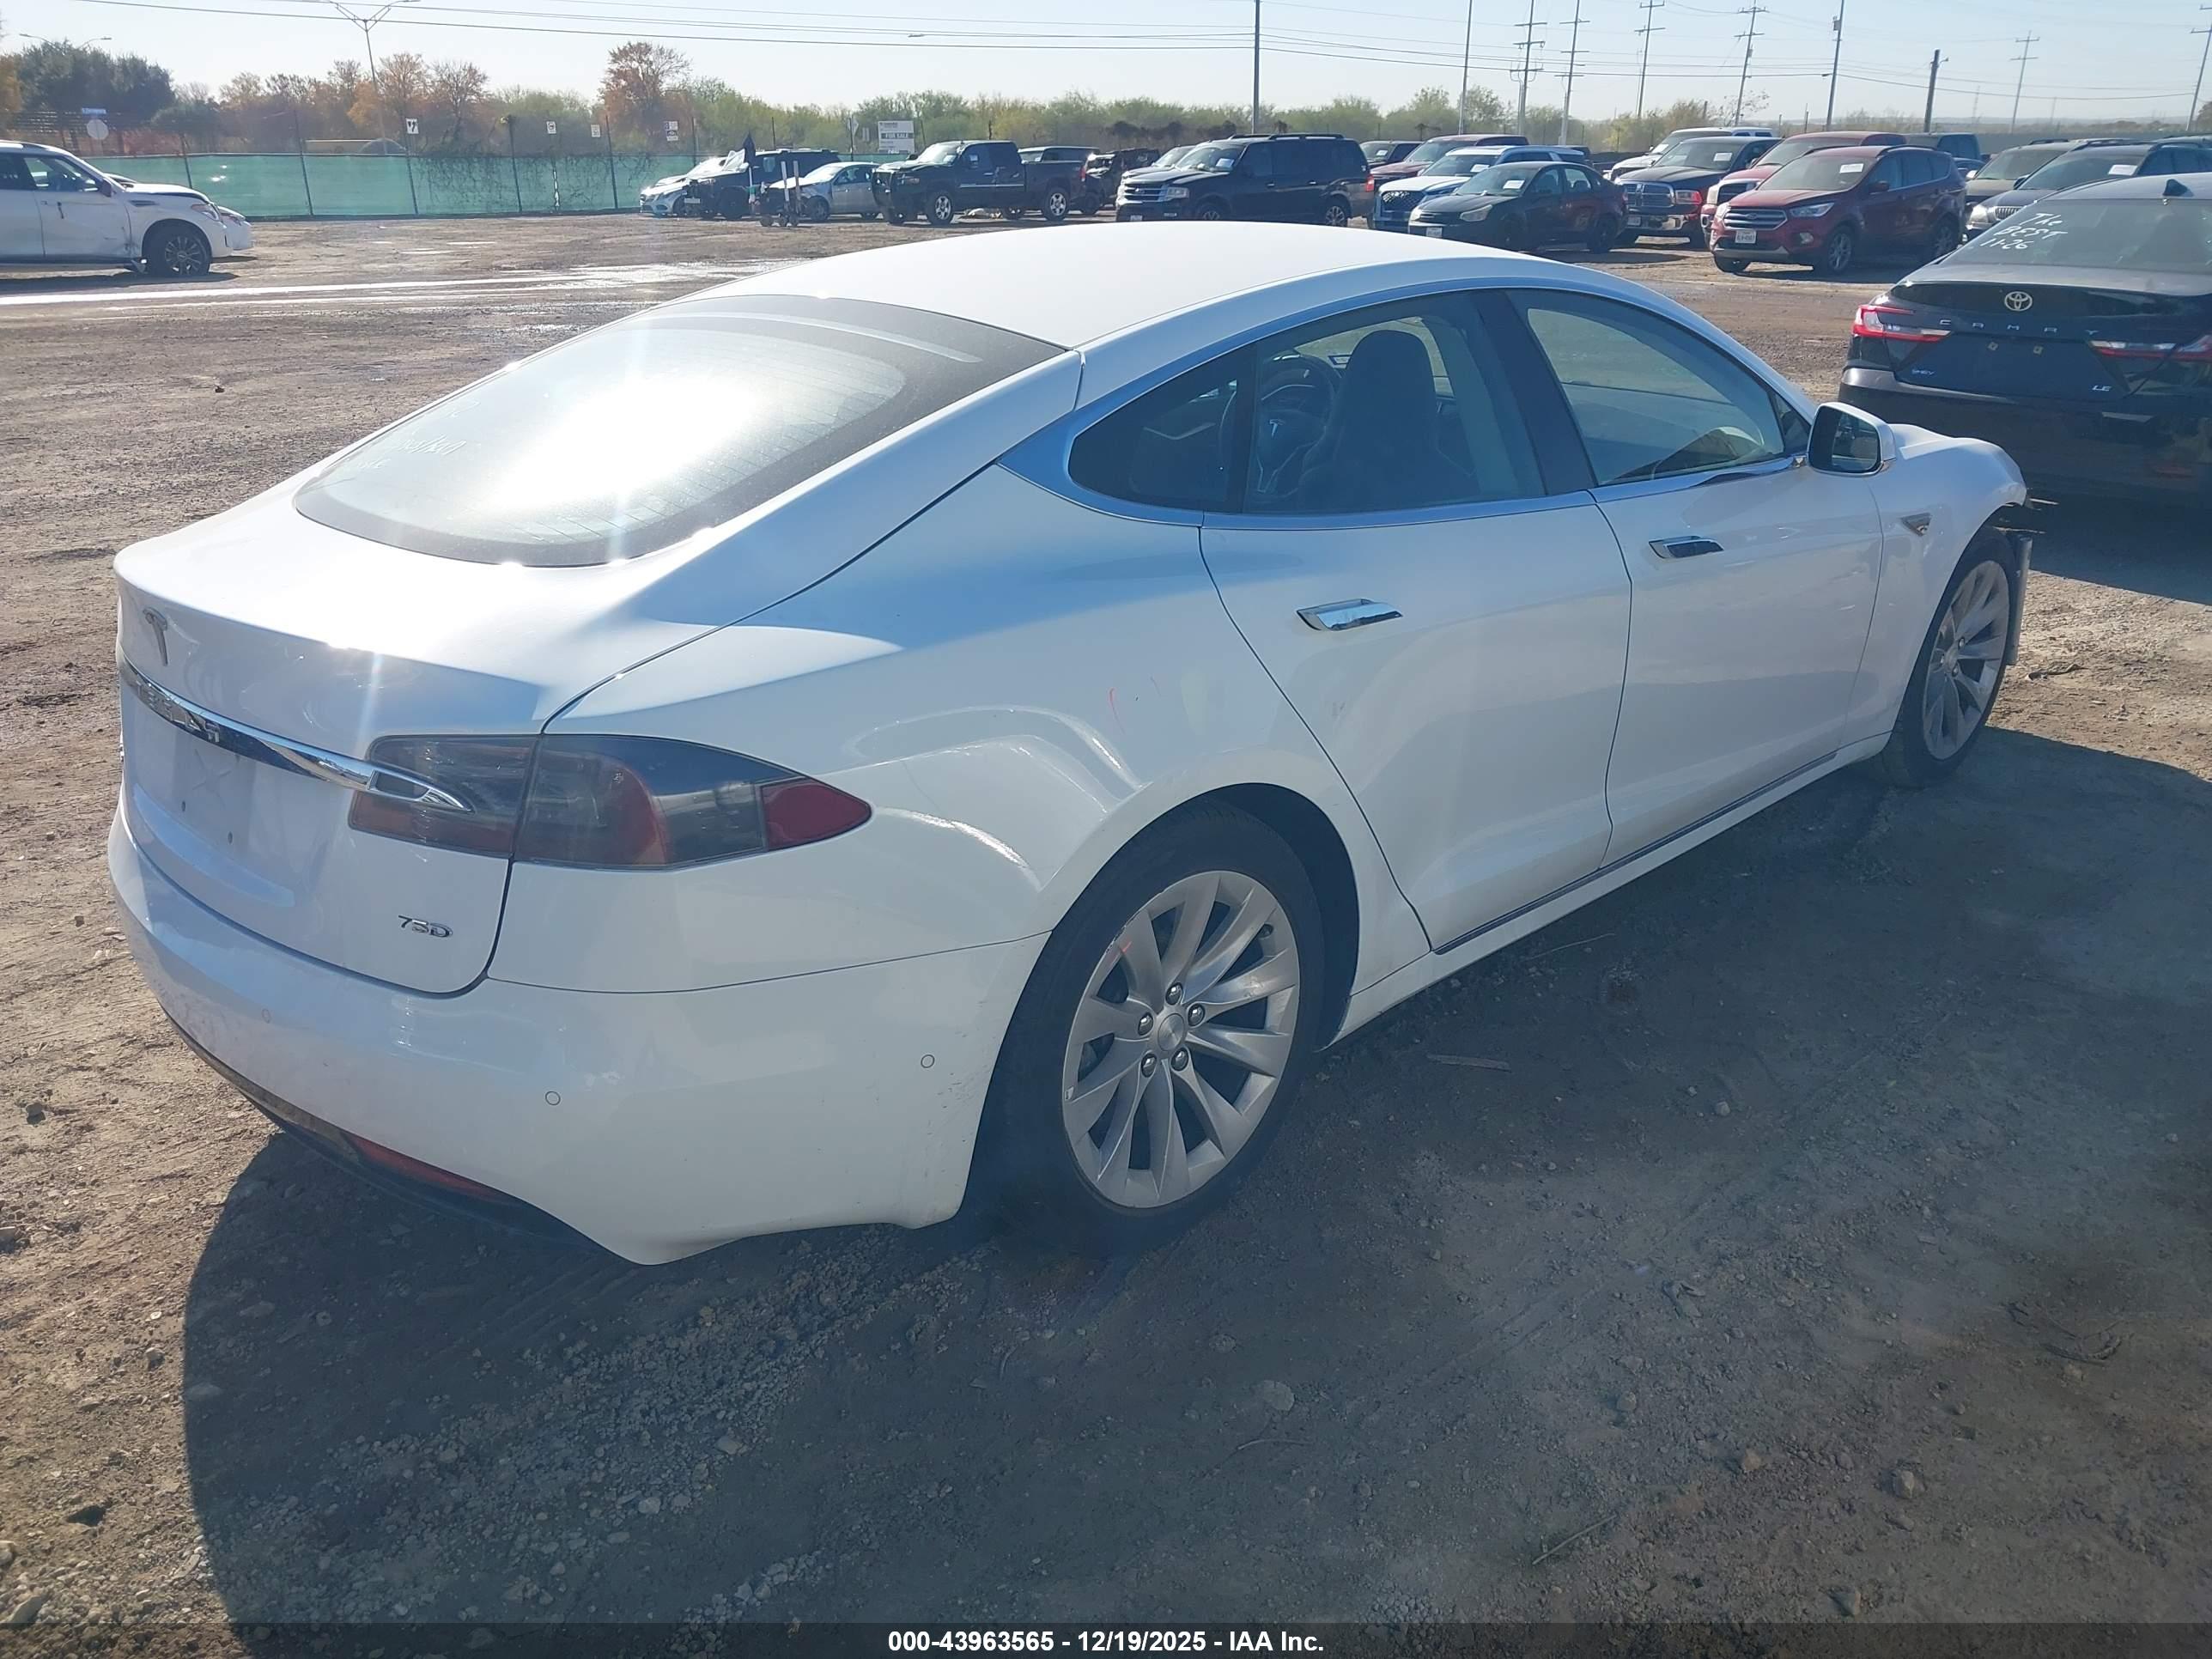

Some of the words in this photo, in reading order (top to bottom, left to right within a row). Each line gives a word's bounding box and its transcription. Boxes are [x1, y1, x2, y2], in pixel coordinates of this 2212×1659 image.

[2019, 213, 2063, 226] The
[1939, 319, 2099, 336] CAMRY
[2092, 384, 2112, 392] LE
[398, 915, 453, 938] 75D
